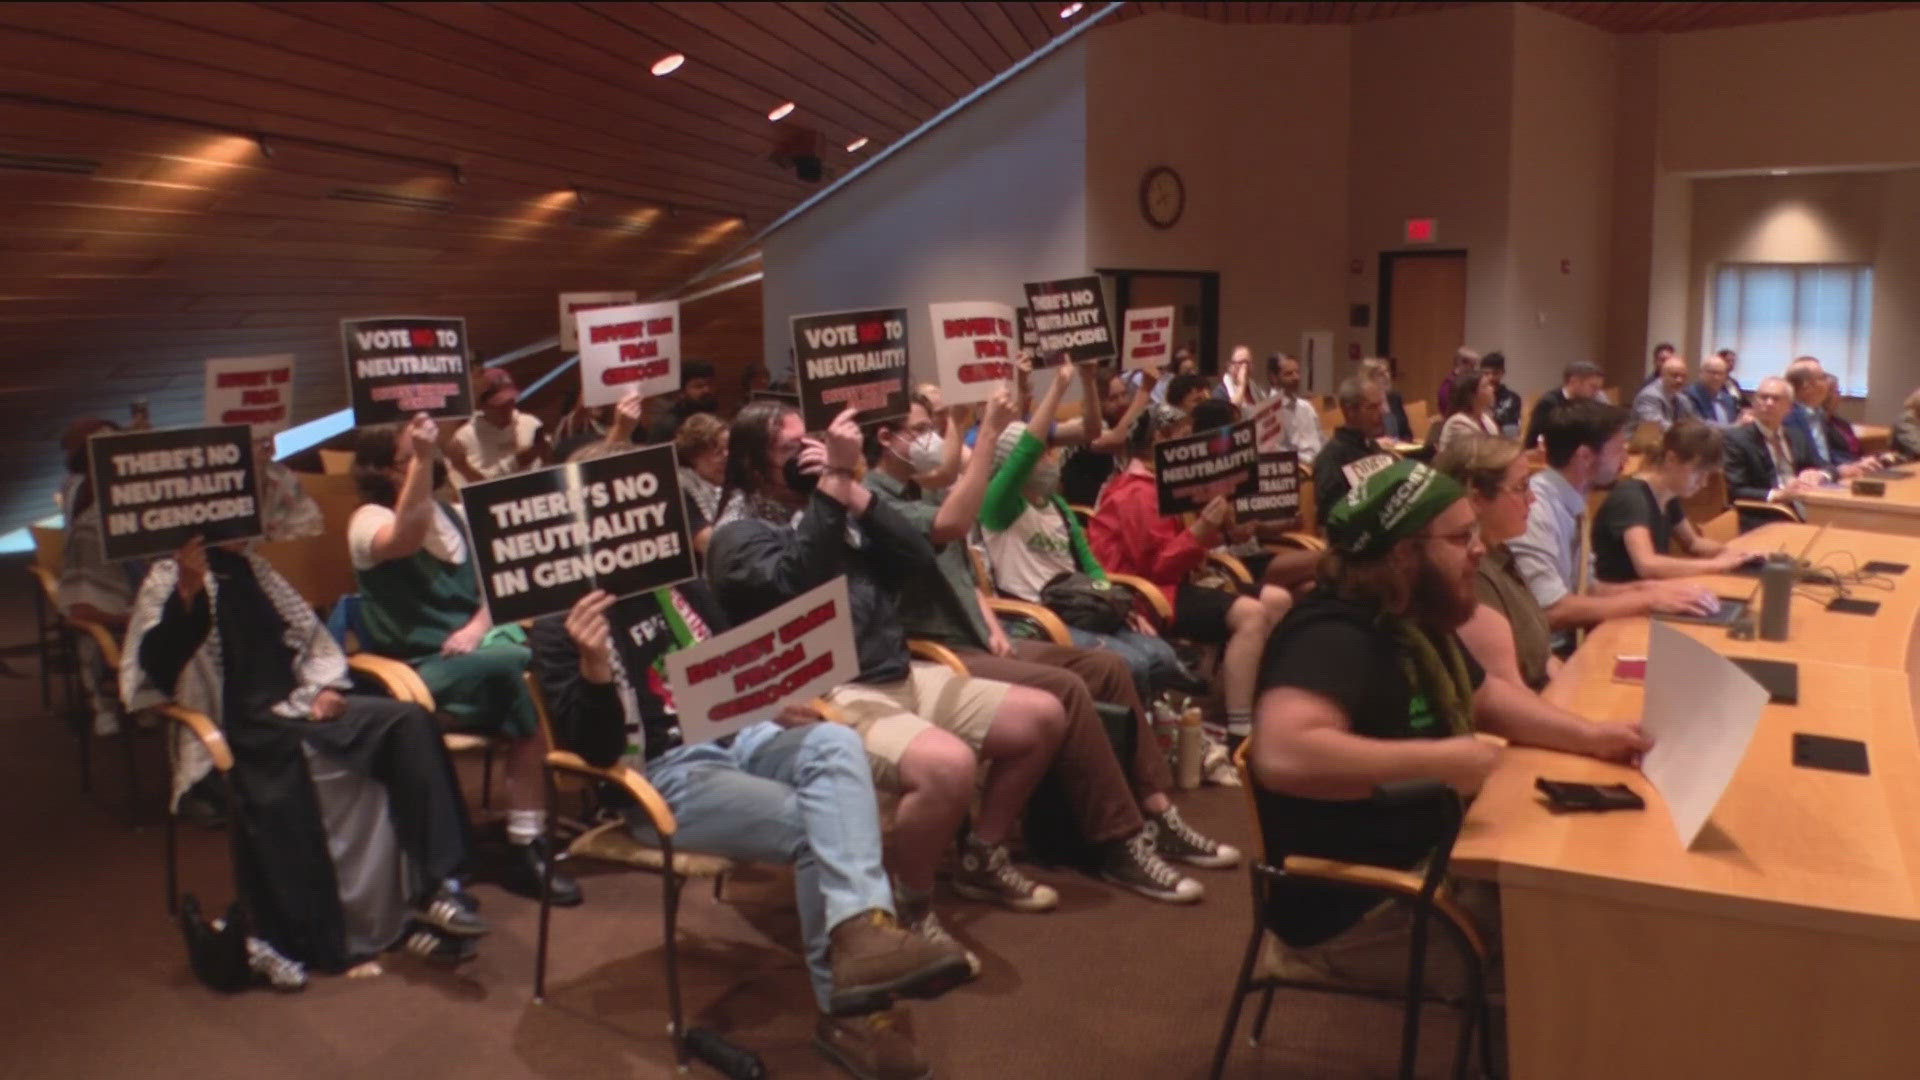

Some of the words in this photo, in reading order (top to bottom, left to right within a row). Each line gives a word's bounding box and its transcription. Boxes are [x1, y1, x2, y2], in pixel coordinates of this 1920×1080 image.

[1071, 289, 1094, 307] NO
[356, 328, 411, 351] VOTE
[436, 328, 458, 349] TO
[803, 324, 858, 350] VOTE
[884, 319, 903, 340] TO
[356, 354, 463, 379] NEUTRALITY!
[805, 347, 906, 380] NEUTRALITY!
[112, 446, 205, 477] THERE'S
[206, 443, 241, 467] NO
[1163, 441, 1209, 464] VOTE
[1232, 428, 1251, 446] TO
[110, 469, 246, 507] NEUTRALITY
[489, 480, 610, 529] THERE'S
[612, 471, 659, 503] NO
[109, 512, 139, 537] IN
[141, 496, 255, 532] GENOCIDE!
[491, 502, 668, 564] NEUTRALITY
[492, 568, 530, 599] IN
[532, 531, 682, 588] GENOCIDE!
